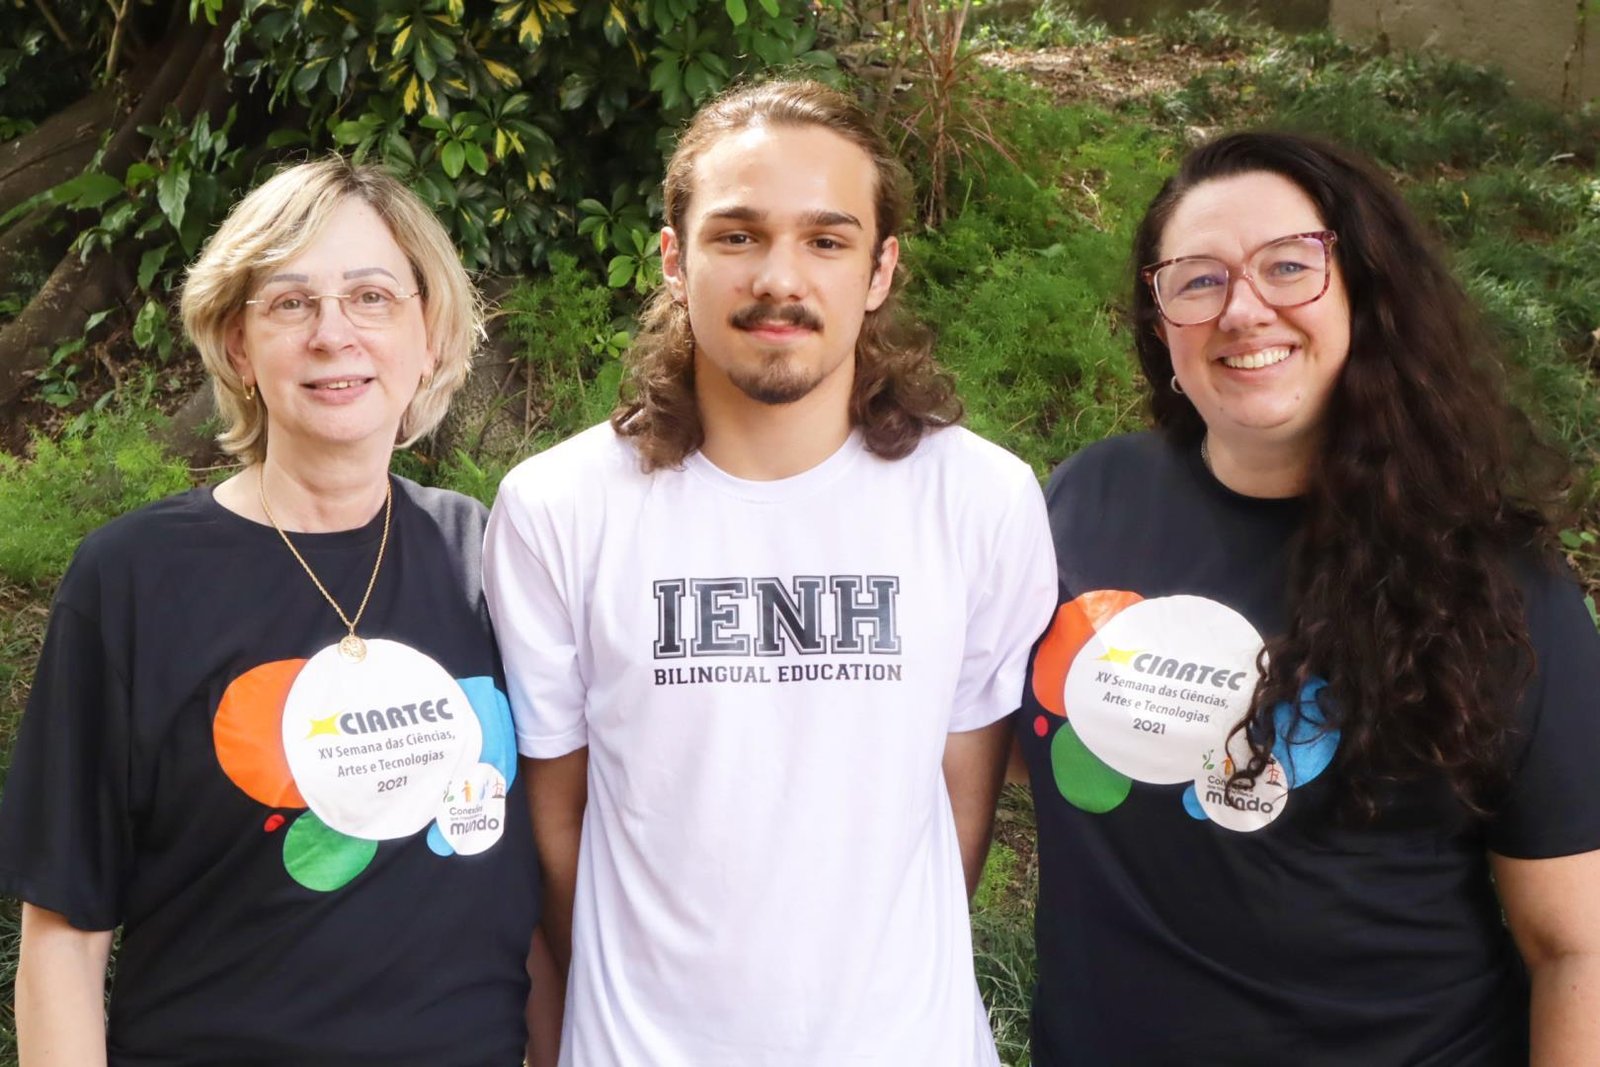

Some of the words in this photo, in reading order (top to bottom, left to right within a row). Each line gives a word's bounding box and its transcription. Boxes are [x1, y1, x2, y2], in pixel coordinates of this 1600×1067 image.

[653, 575, 902, 659] IENH
[654, 666, 771, 685] BILINGUAL
[778, 663, 902, 683] EDUCATION
[1133, 653, 1247, 691] CIARTEC
[1096, 671, 1111, 683] XV
[1111, 675, 1156, 694] Semana
[1158, 683, 1178, 698] das
[1179, 688, 1229, 709] Ciências,
[339, 698, 454, 735] CIARTEC
[1103, 692, 1132, 707] Artes
[1134, 701, 1142, 709] e
[1144, 700, 1210, 723] Tecnologias
[1133, 718, 1166, 735] 2021
[318, 747, 333, 760] XV
[336, 741, 383, 758] Semana
[386, 737, 404, 750] das
[406, 730, 456, 746] Ciências,
[337, 761, 368, 778] Artes
[371, 763, 377, 772] e
[379, 750, 444, 771] Tecnologias
[377, 776, 408, 793] 2021
[450, 815, 500, 836] mundo
